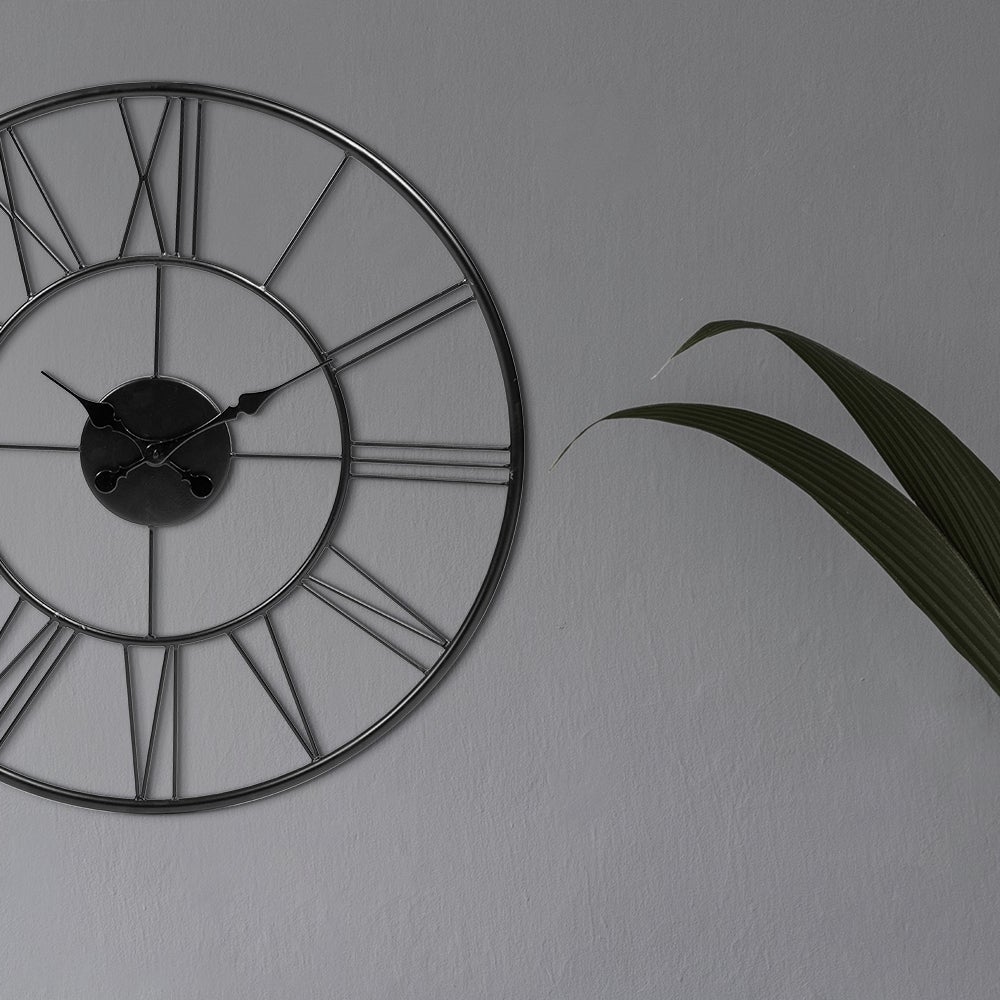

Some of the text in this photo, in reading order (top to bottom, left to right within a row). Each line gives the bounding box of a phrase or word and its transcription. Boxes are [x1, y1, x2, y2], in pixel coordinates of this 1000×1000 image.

[116, 97, 204, 259] XII
[262, 152, 352, 290] I
[323, 279, 476, 374] II
[350, 440, 511, 486] III
[299, 545, 451, 675] IV
[123, 643, 180, 800] VI
[227, 612, 322, 762] V
